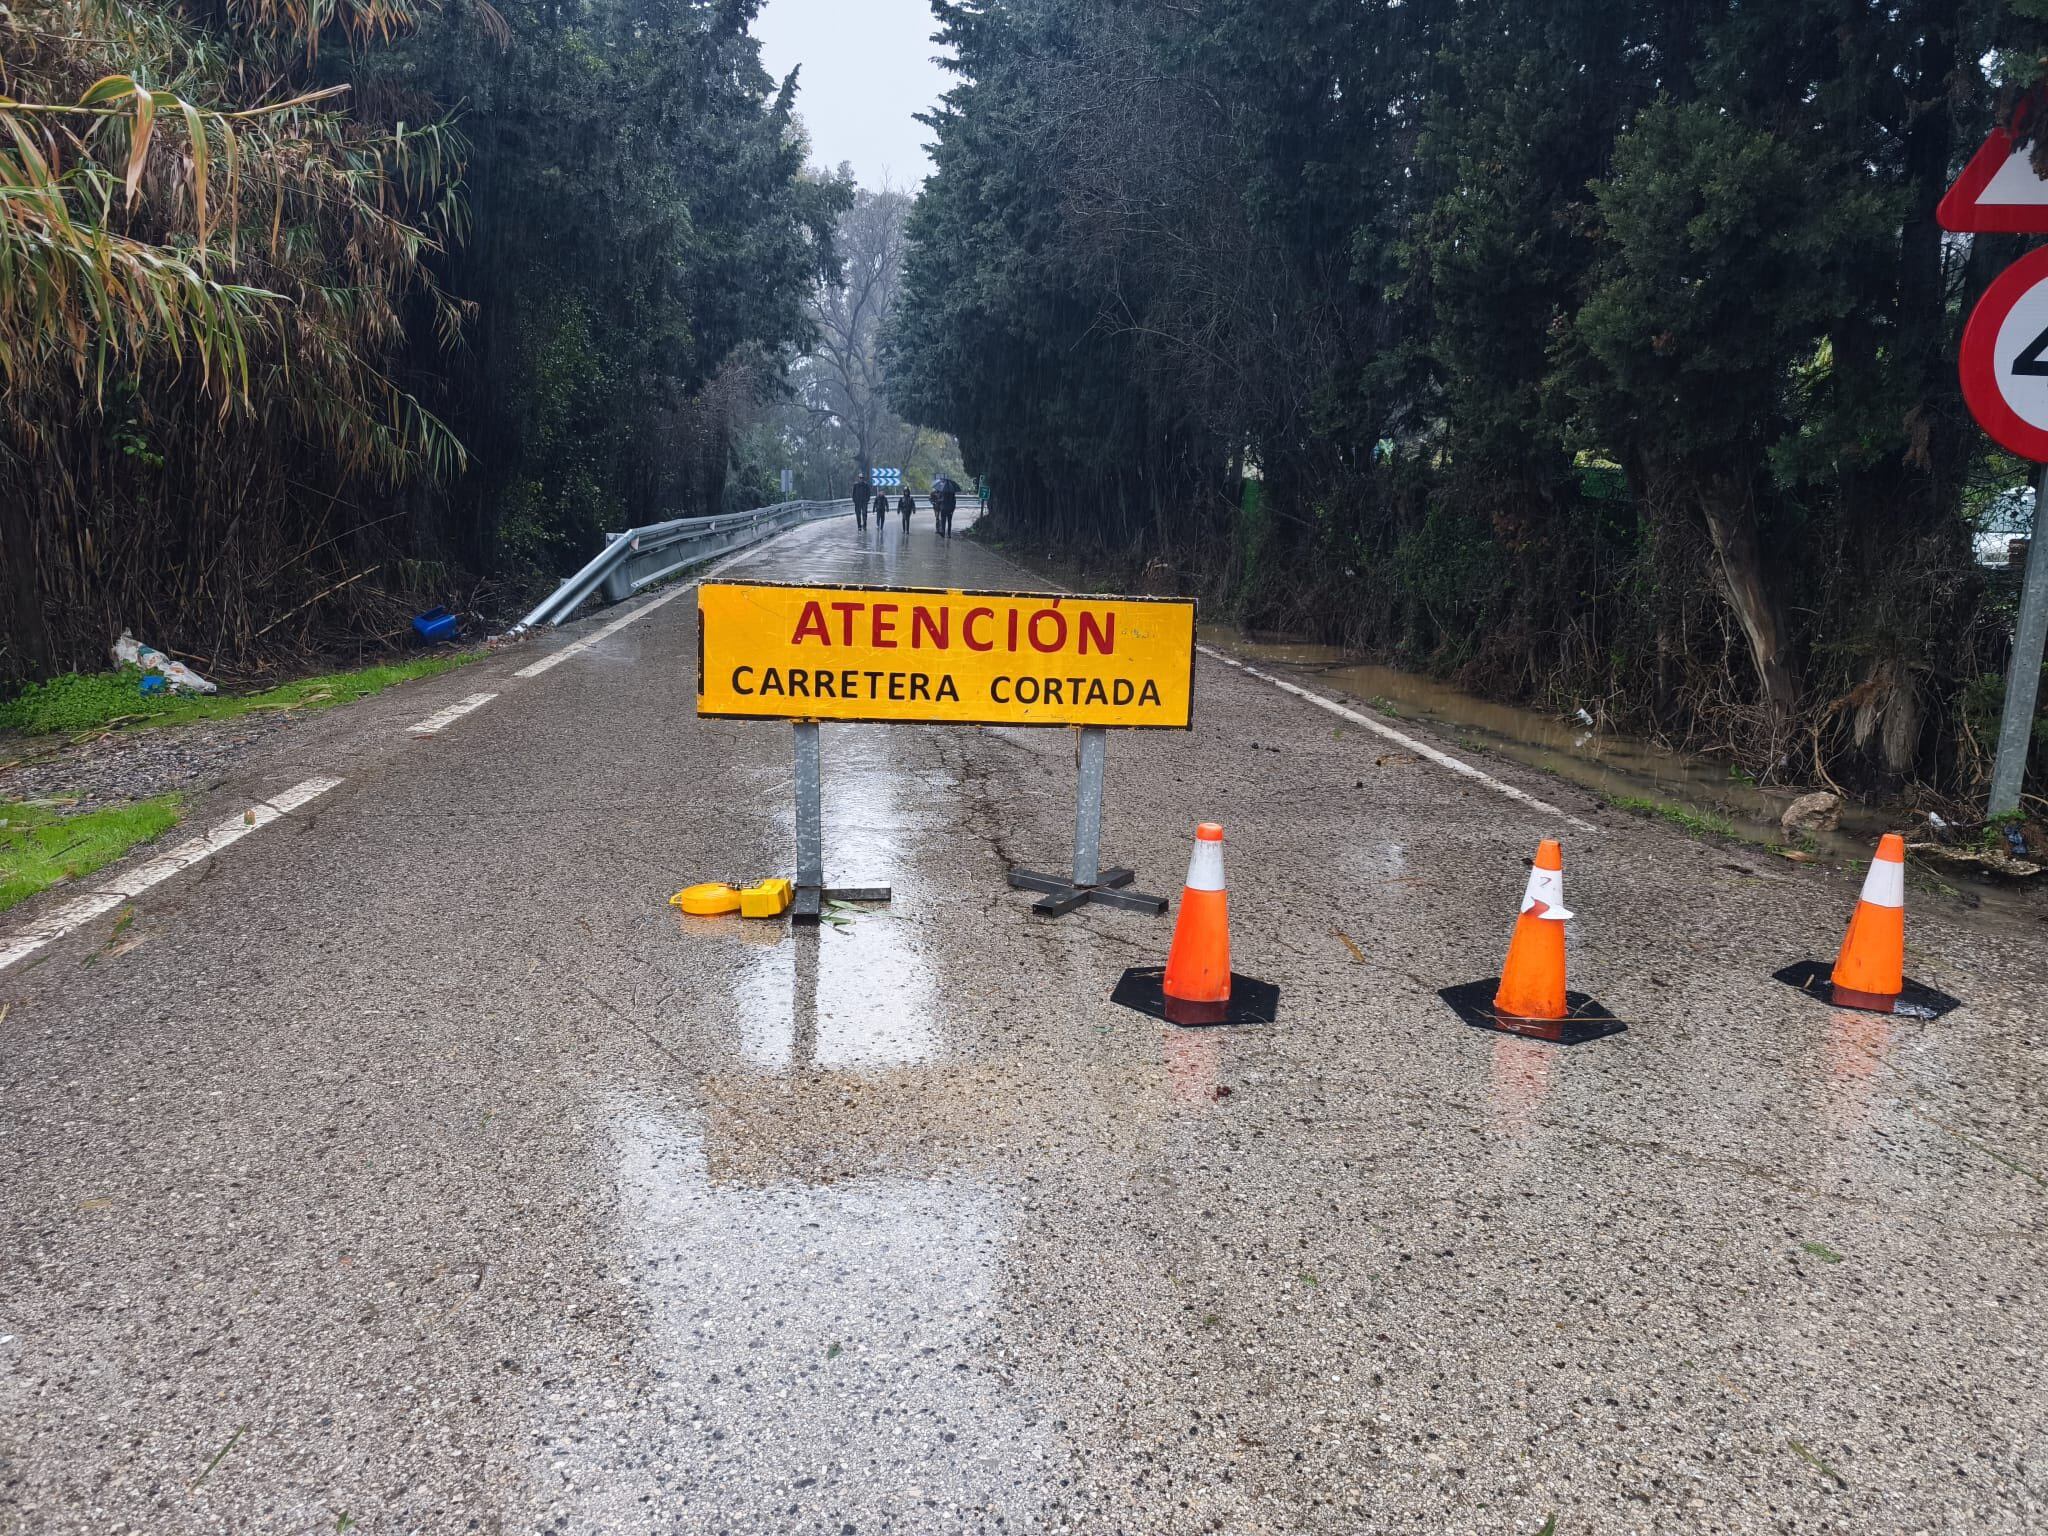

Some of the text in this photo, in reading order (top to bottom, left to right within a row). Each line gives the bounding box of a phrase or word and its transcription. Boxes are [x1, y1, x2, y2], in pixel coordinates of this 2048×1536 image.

[791, 598, 1115, 655] ATENCIÓN
[732, 665, 1162, 706] CARRETERA CORTADA
